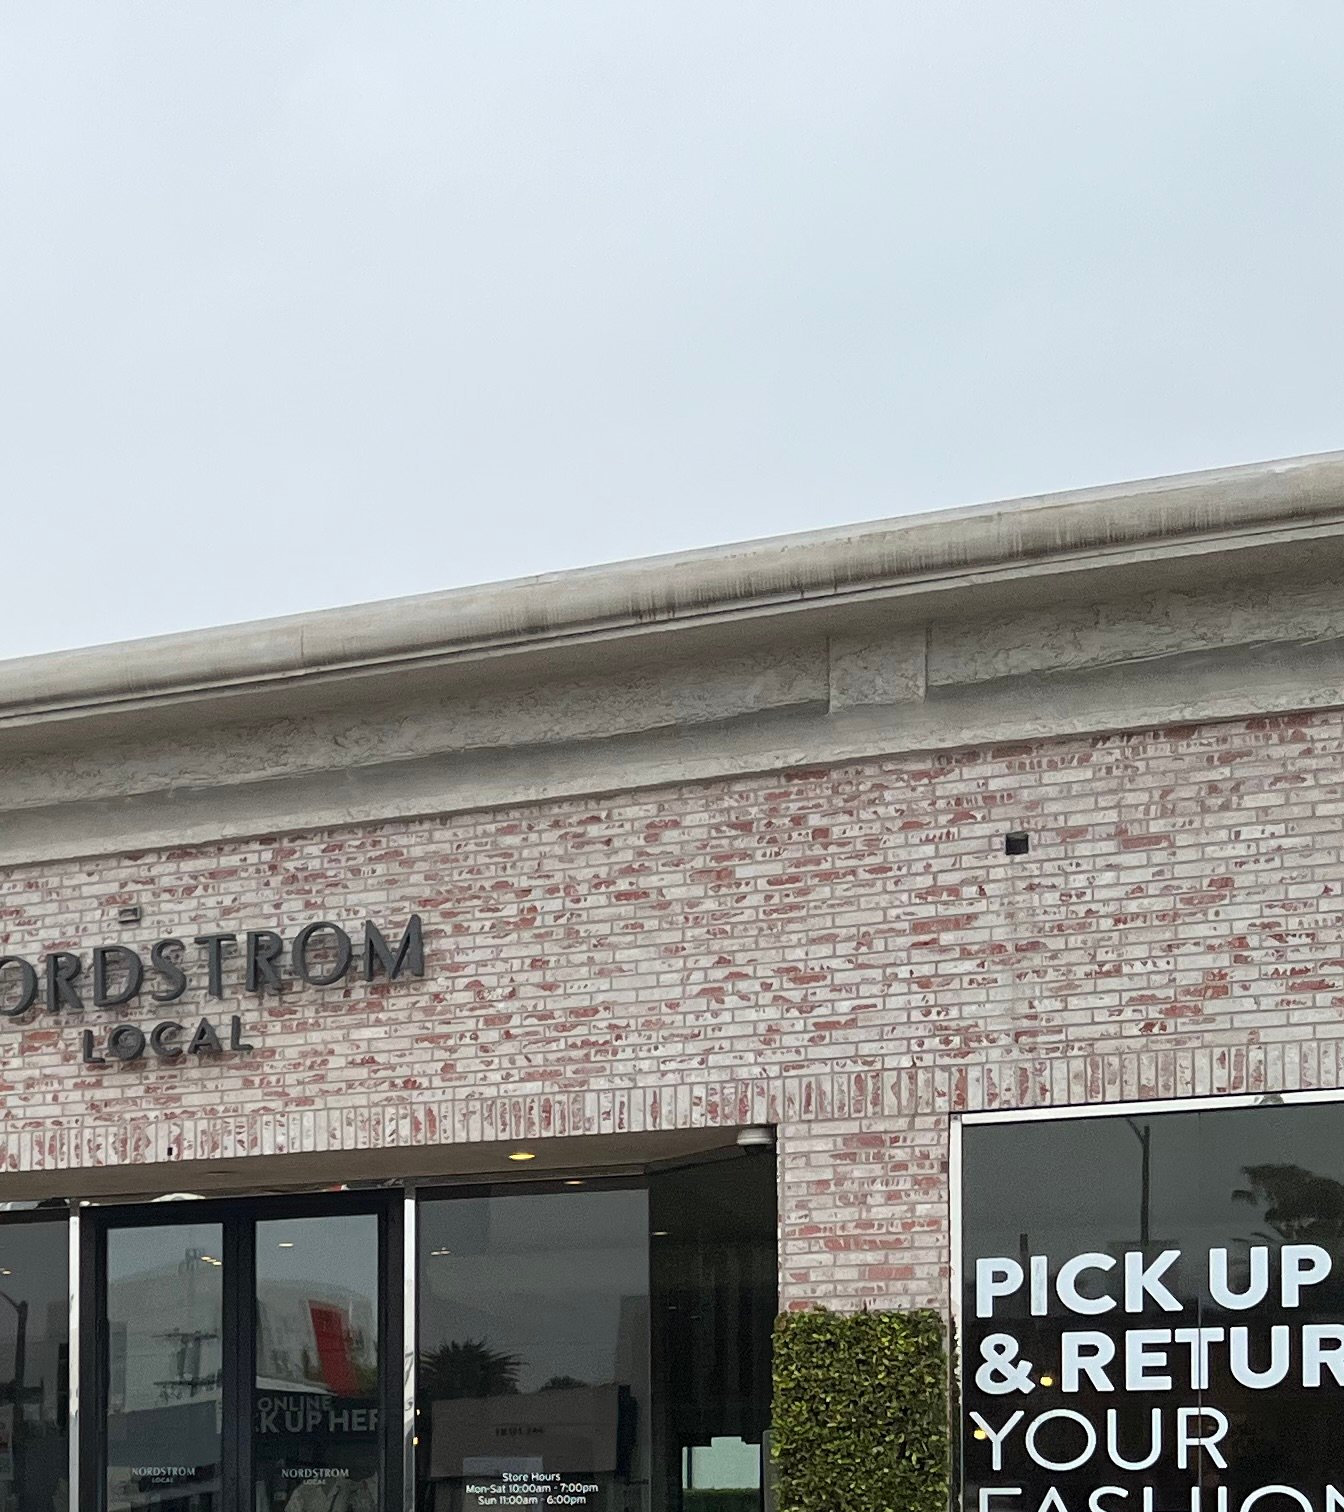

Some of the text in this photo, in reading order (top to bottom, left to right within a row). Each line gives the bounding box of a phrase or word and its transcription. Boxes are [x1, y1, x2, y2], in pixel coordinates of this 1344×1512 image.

[83, 1015, 254, 1064] LOCAL
[976, 1245, 1332, 1318] PICK UP
[975, 1324, 1344, 1395] & RETUR
[969, 1407, 1229, 1471] YOUR
[132, 1466, 196, 1476] NORDSTROM
[281, 1468, 350, 1478] NORDSTROM
[502, 1472, 561, 1481] Store Hours
[465, 1484, 506, 1494] Mon-Sat
[508, 1483, 551, 1493] 10:00am
[559, 1483, 599, 1496] 7:00pm
[478, 1495, 497, 1505] Sun
[499, 1495, 538, 1505] 11:00am
[546, 1495, 587, 1506] 6:00pm
